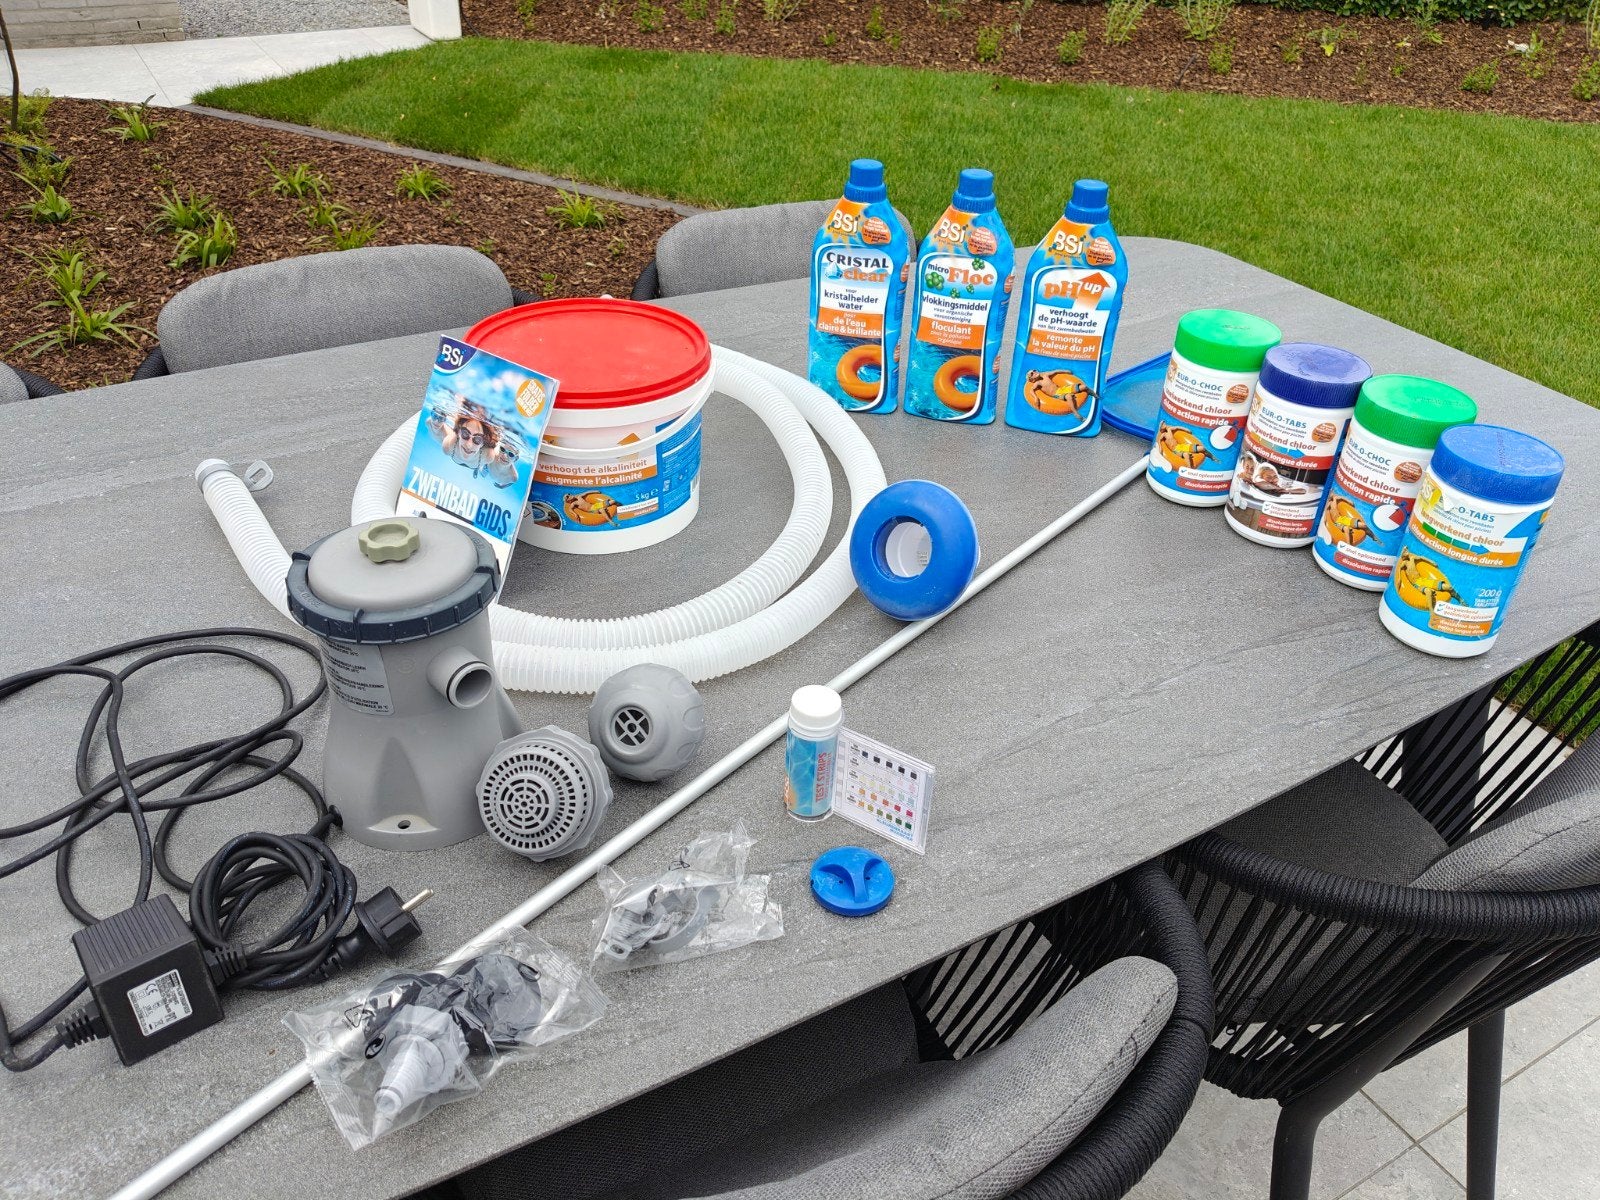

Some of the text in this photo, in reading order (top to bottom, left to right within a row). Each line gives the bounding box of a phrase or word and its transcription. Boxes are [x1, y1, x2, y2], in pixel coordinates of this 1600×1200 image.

[826, 252, 889, 268] CRISTAL
[843, 267, 888, 282] clear
[928, 264, 994, 286] micro Floc
[824, 290, 878, 304] kristalhelder
[1044, 281, 1102, 298] pH up
[838, 302, 862, 310] water
[923, 295, 988, 310] vlokkingsmiddel
[1038, 314, 1097, 327] de pH-waarde
[1050, 309, 1088, 320] verhoogt
[818, 321, 840, 332] claire
[848, 326, 881, 336] brillante
[846, 318, 866, 328] l'eau
[932, 321, 972, 334] floculant
[1041, 341, 1068, 350] valeur
[1070, 344, 1081, 352] du
[1046, 334, 1082, 344] remonte
[1178, 372, 1224, 392] EUR-O-CHOC
[1177, 408, 1200, 422] action
[1202, 416, 1229, 426] rapide
[1205, 406, 1232, 414] chloor
[1262, 406, 1307, 429] EUR-O-TABS
[1290, 440, 1317, 450] chloor
[1271, 453, 1295, 466] longue
[538, 460, 647, 475] verhoogt de alkaliniteit
[546, 471, 642, 486] augmente l'alcalinité
[1340, 458, 1368, 483] werkend
[1370, 478, 1400, 493] chloor
[1365, 489, 1396, 505] rapide
[1473, 534, 1504, 546] chloor
[1426, 537, 1448, 552] action
[1448, 546, 1478, 563] longue
[1479, 556, 1504, 566] durée
[1342, 558, 1372, 572] dissolution
[1478, 588, 1496, 597] 200
[816, 752, 827, 802] TEST STRIPS
